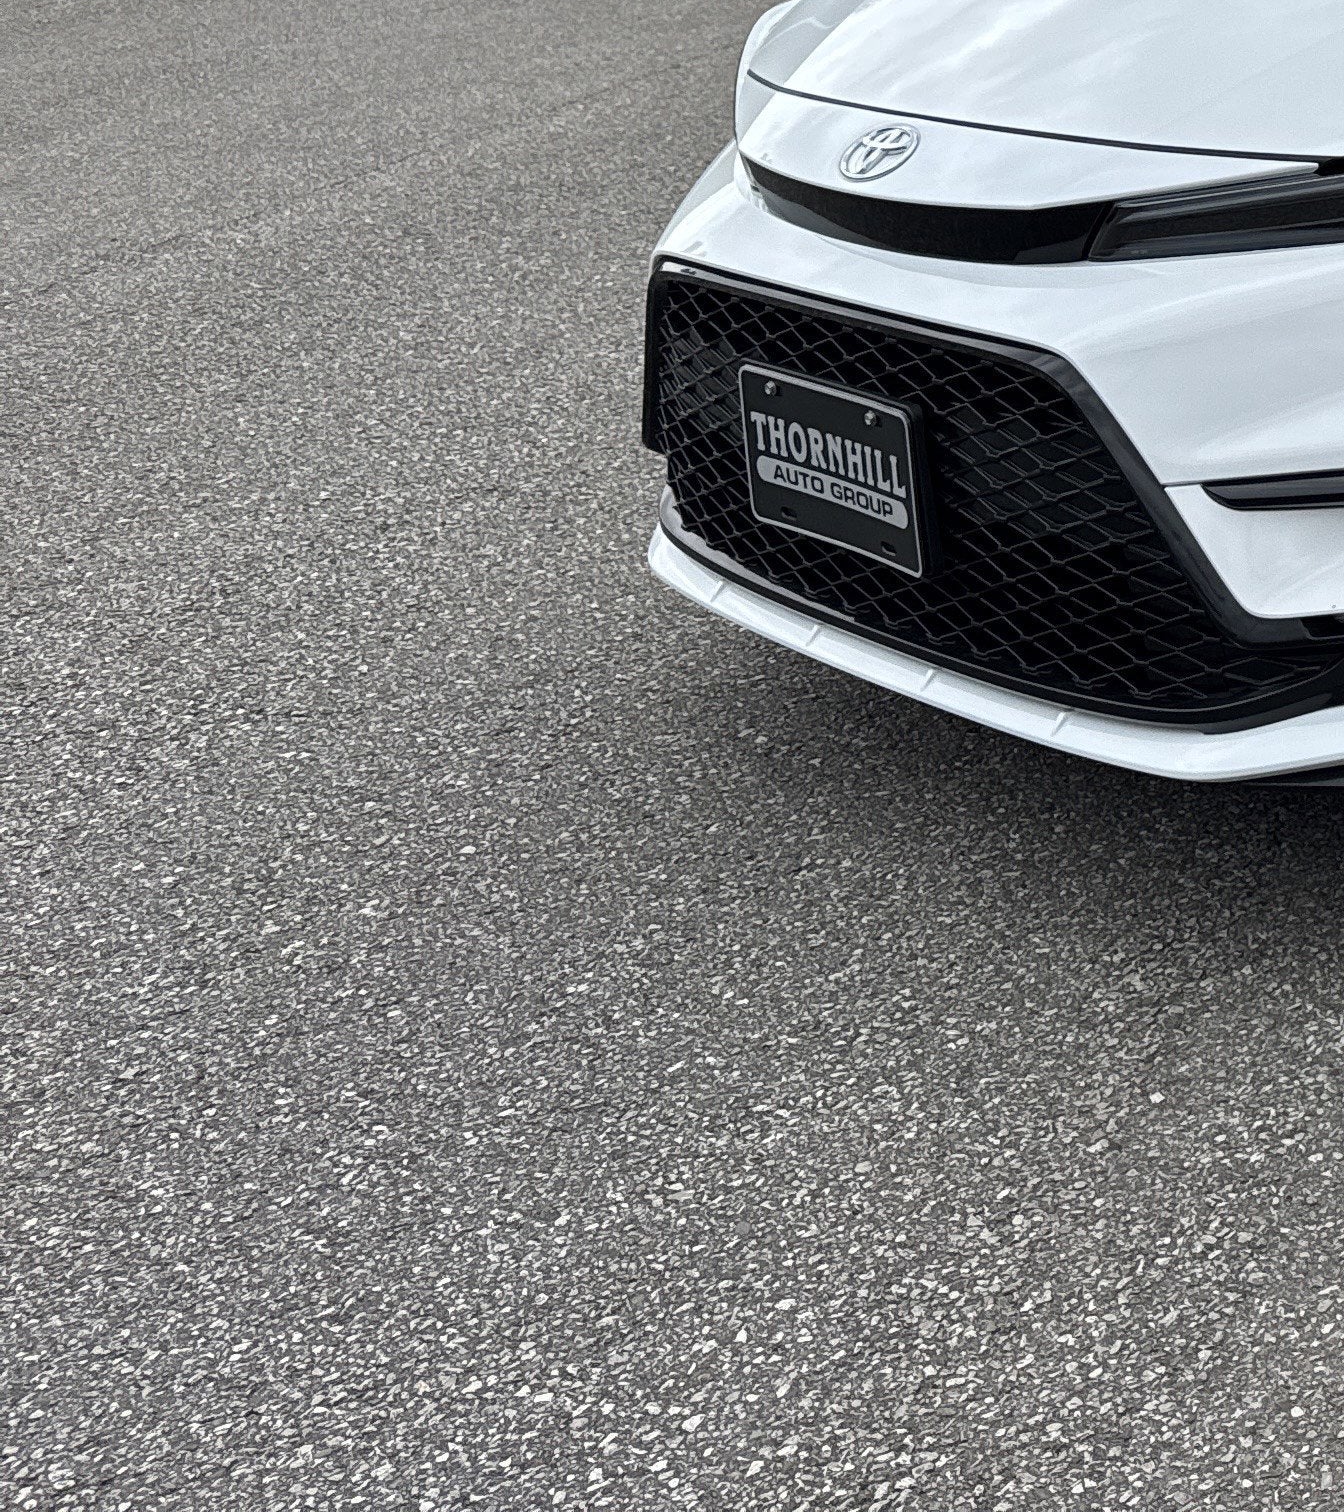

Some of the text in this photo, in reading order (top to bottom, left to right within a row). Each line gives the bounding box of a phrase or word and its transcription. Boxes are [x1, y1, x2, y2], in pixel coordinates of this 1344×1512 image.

[750, 410, 907, 499] THORNHILL
[773, 464, 894, 518] AUTO GROUP
